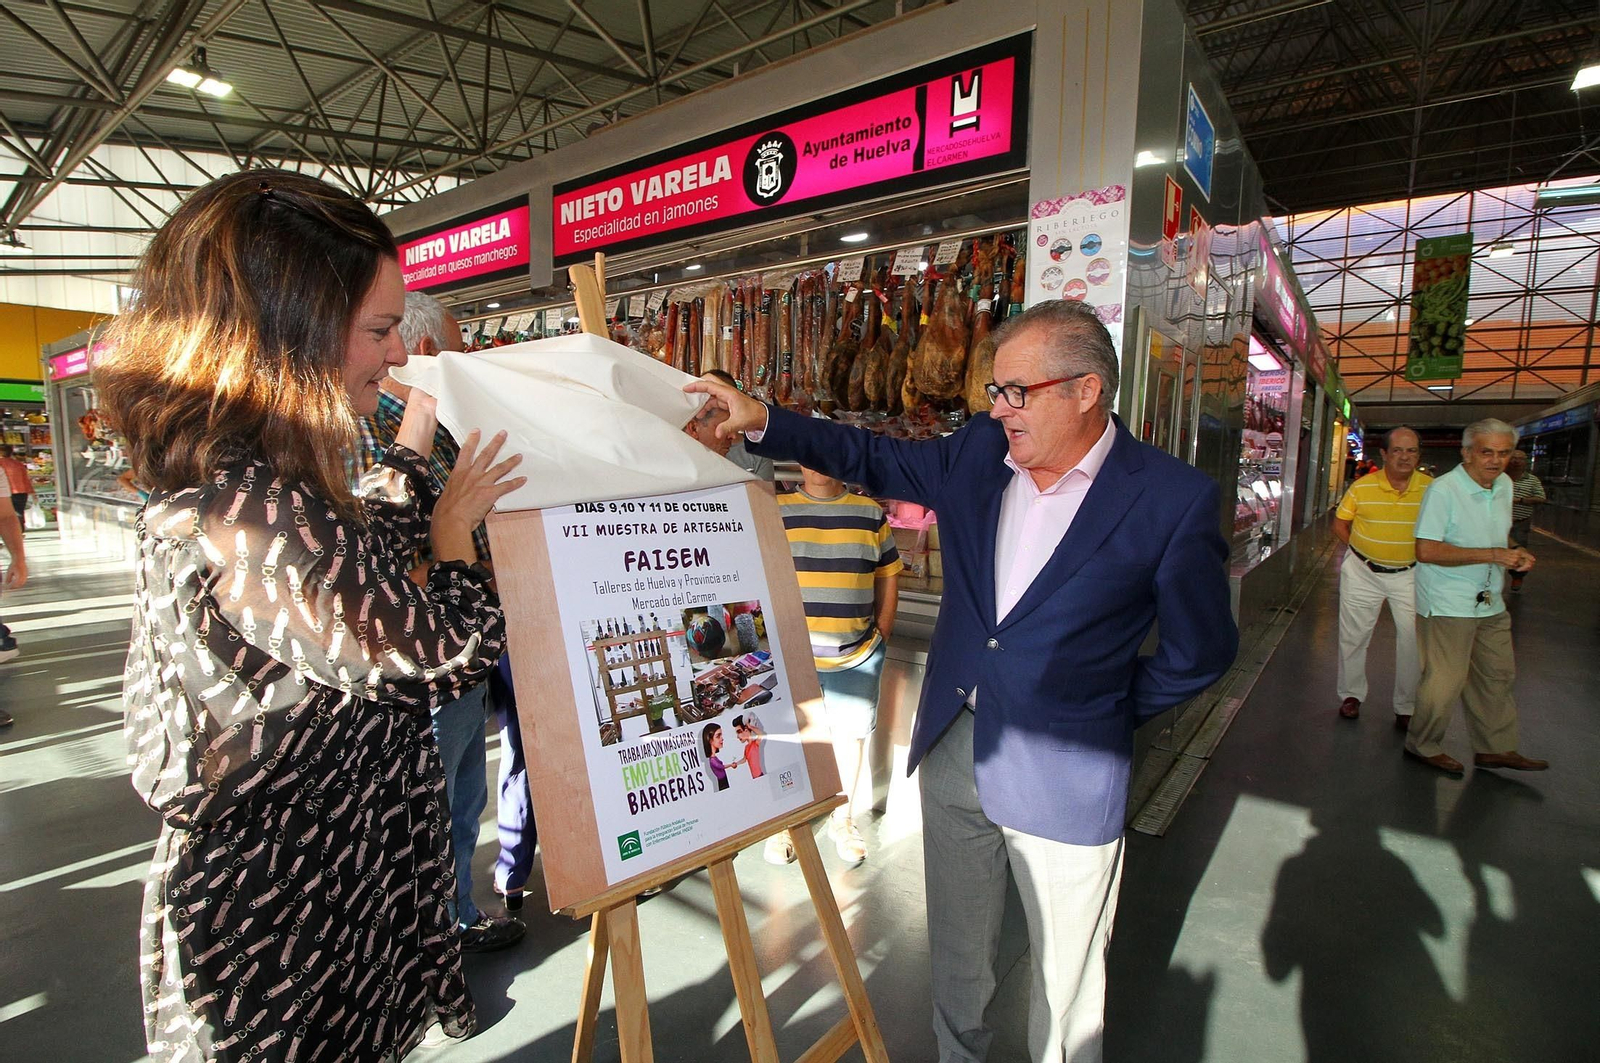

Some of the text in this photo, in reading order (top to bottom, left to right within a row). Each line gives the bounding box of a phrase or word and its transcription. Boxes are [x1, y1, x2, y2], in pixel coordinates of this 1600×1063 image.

[803, 116, 912, 157] Ayuntamiento
[829, 139, 911, 169] de Huelva
[560, 155, 732, 225] NIETO VARELA
[574, 195, 719, 243] Especialidad en jamones
[1036, 209, 1119, 233] RIBERIEGO
[405, 217, 511, 267] NIETO VARELA
[403, 245, 518, 285] specialidad en quesos manchegos
[609, 502, 635, 515] 9,10
[638, 502, 646, 512] Y
[649, 502, 662, 512] 11
[664, 503, 679, 512] DE
[682, 503, 729, 512] OCTUBRE
[562, 519, 744, 538] VII MUESTRA DE ARTESANÍA
[624, 547, 711, 573] FAISEM
[593, 570, 740, 595] Talleres de Huelva y Provincia en el
[632, 591, 717, 610] Mercado del Carmen
[618, 733, 696, 765] TRABAJAR SIN MÁSCARAS
[622, 747, 700, 792] EMPLEAR SIN
[627, 771, 705, 815] BARRERAS
